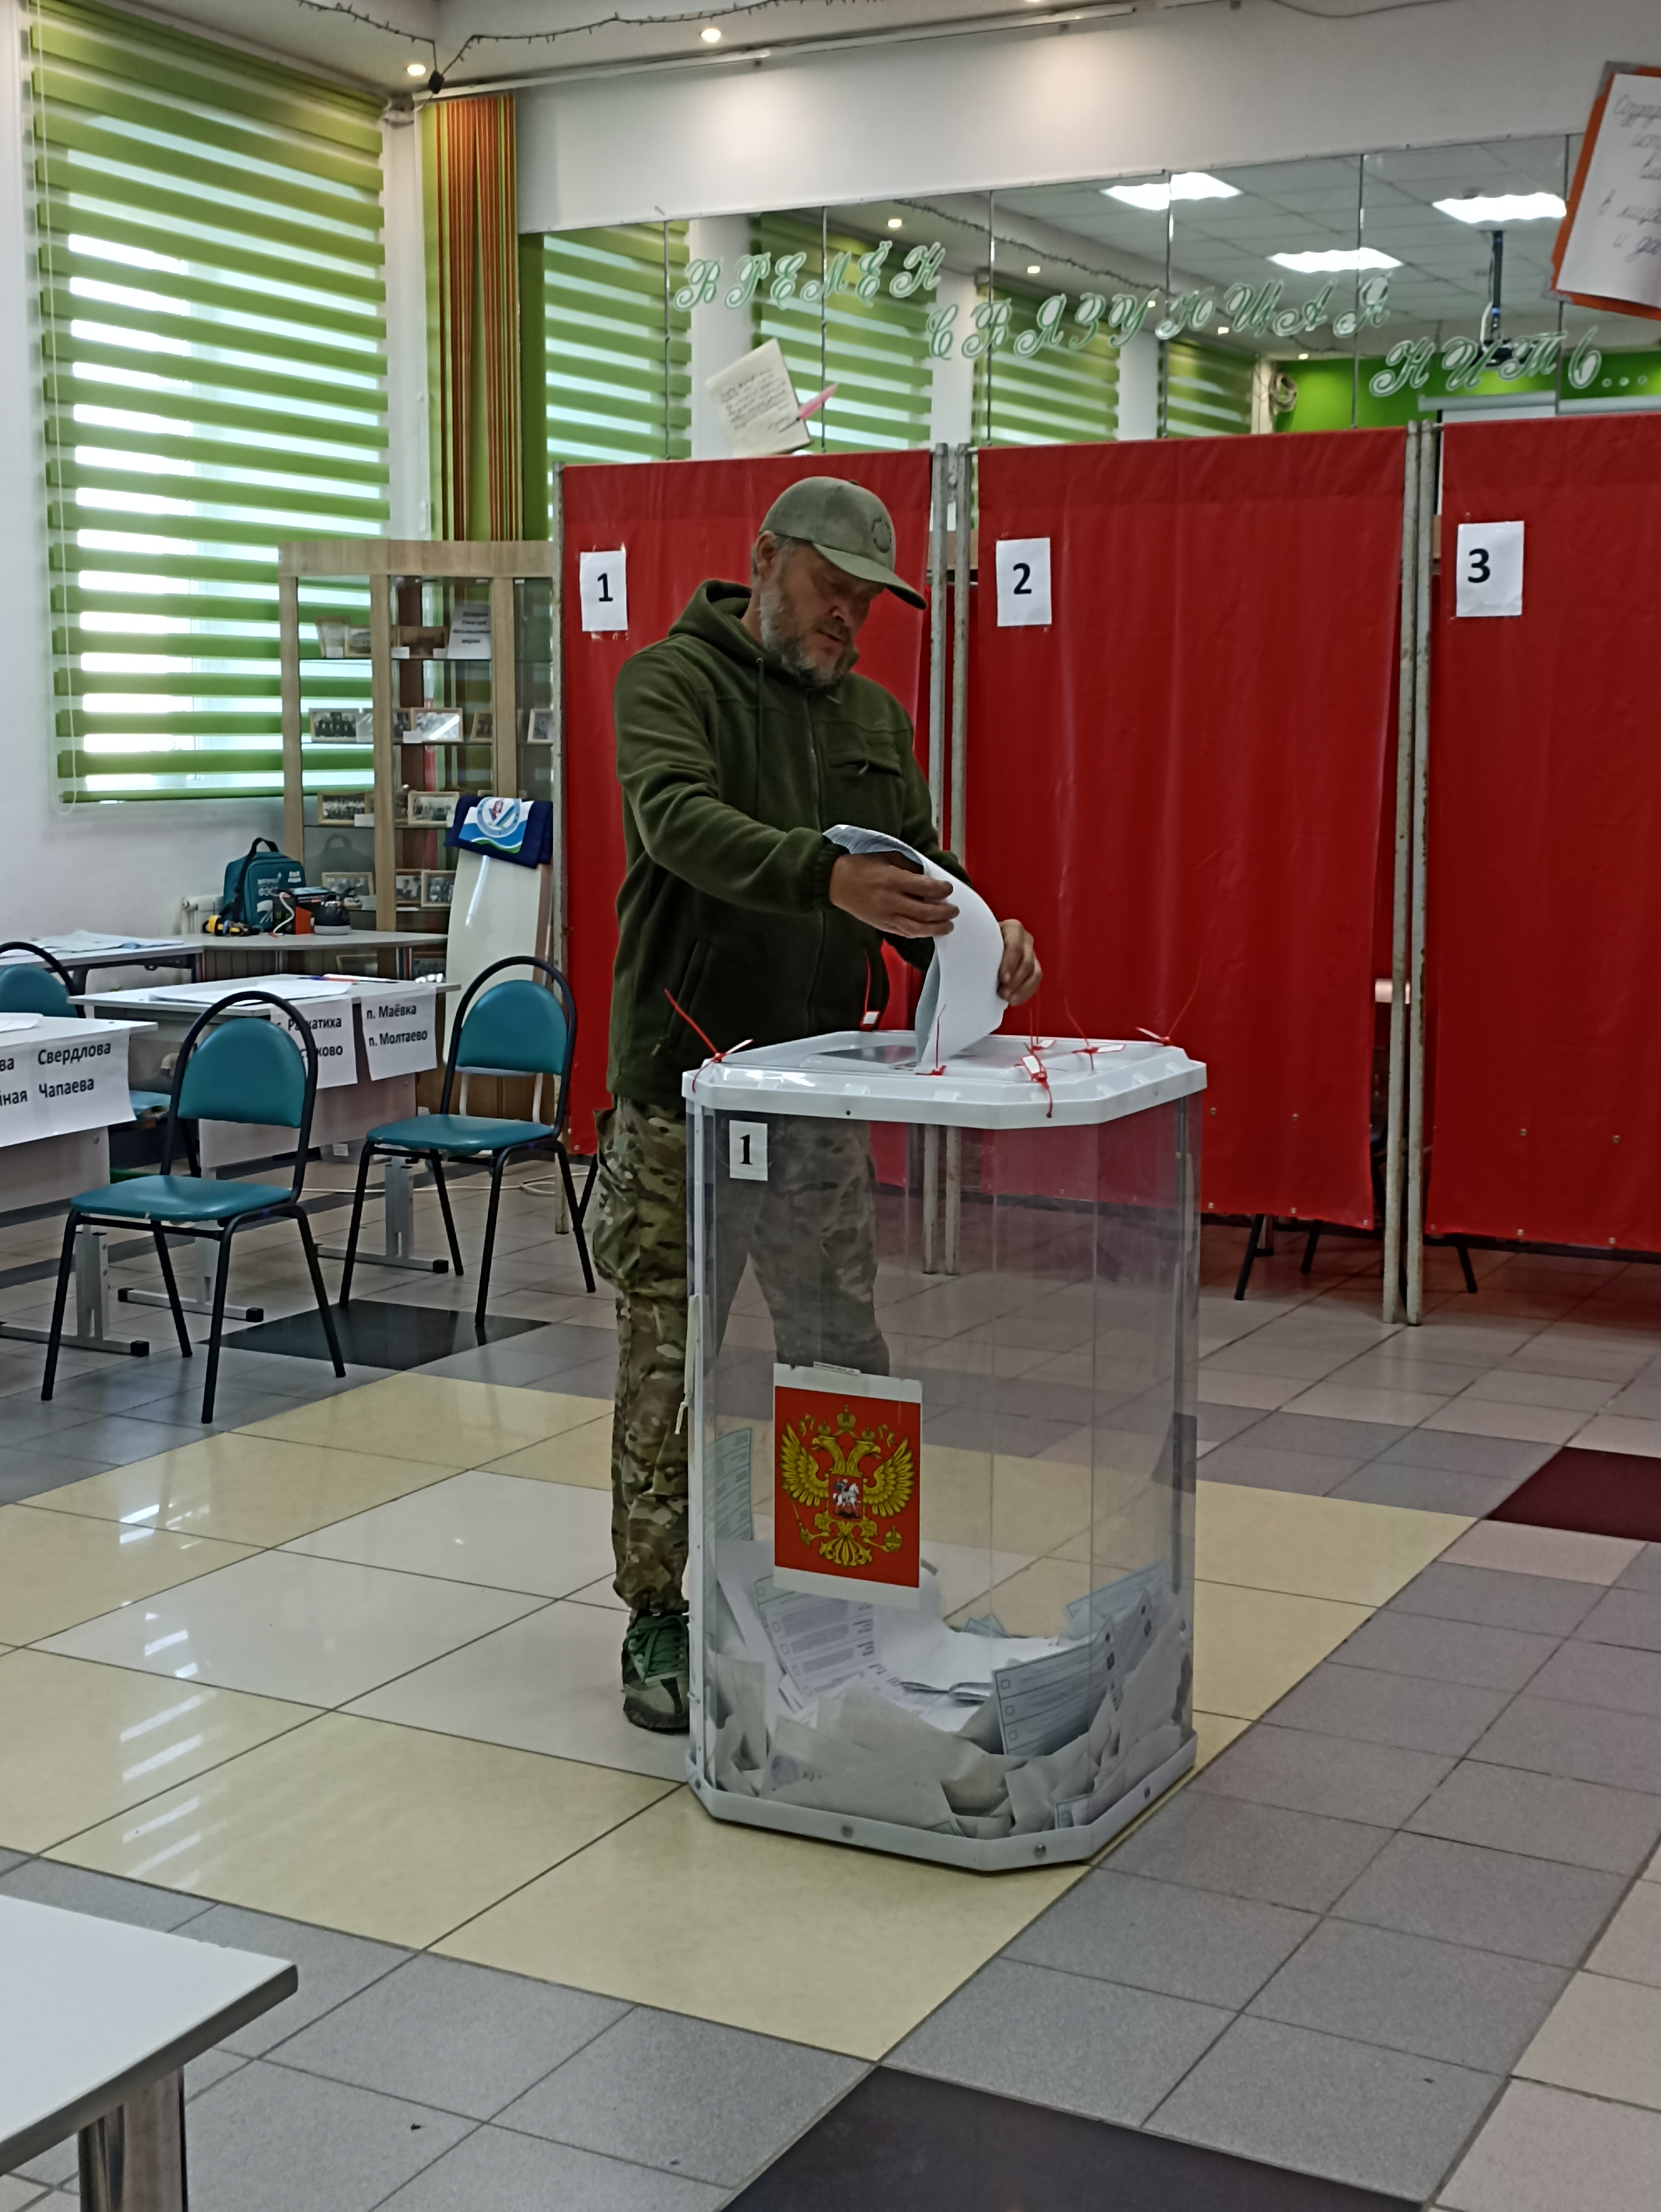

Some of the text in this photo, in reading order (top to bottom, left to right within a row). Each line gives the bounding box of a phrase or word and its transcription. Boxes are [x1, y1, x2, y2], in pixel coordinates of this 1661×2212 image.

[674, 241, 945, 310] ВРЕМЁН
[926, 272, 1393, 360] СВЯЗУЮЩАЯ
[1013, 563, 1032, 595] 2
[1467, 548, 1491, 583] 3
[598, 573, 613, 601] 1
[288, 1018, 342, 1031] Ракатиха
[366, 1004, 417, 1020] п. Маёвка
[369, 1030, 428, 1047] п. Молтаево
[38, 1042, 111, 1065] Свердлова
[39, 1078, 94, 1098] Чапаева
[740, 1133, 753, 1165] 1
